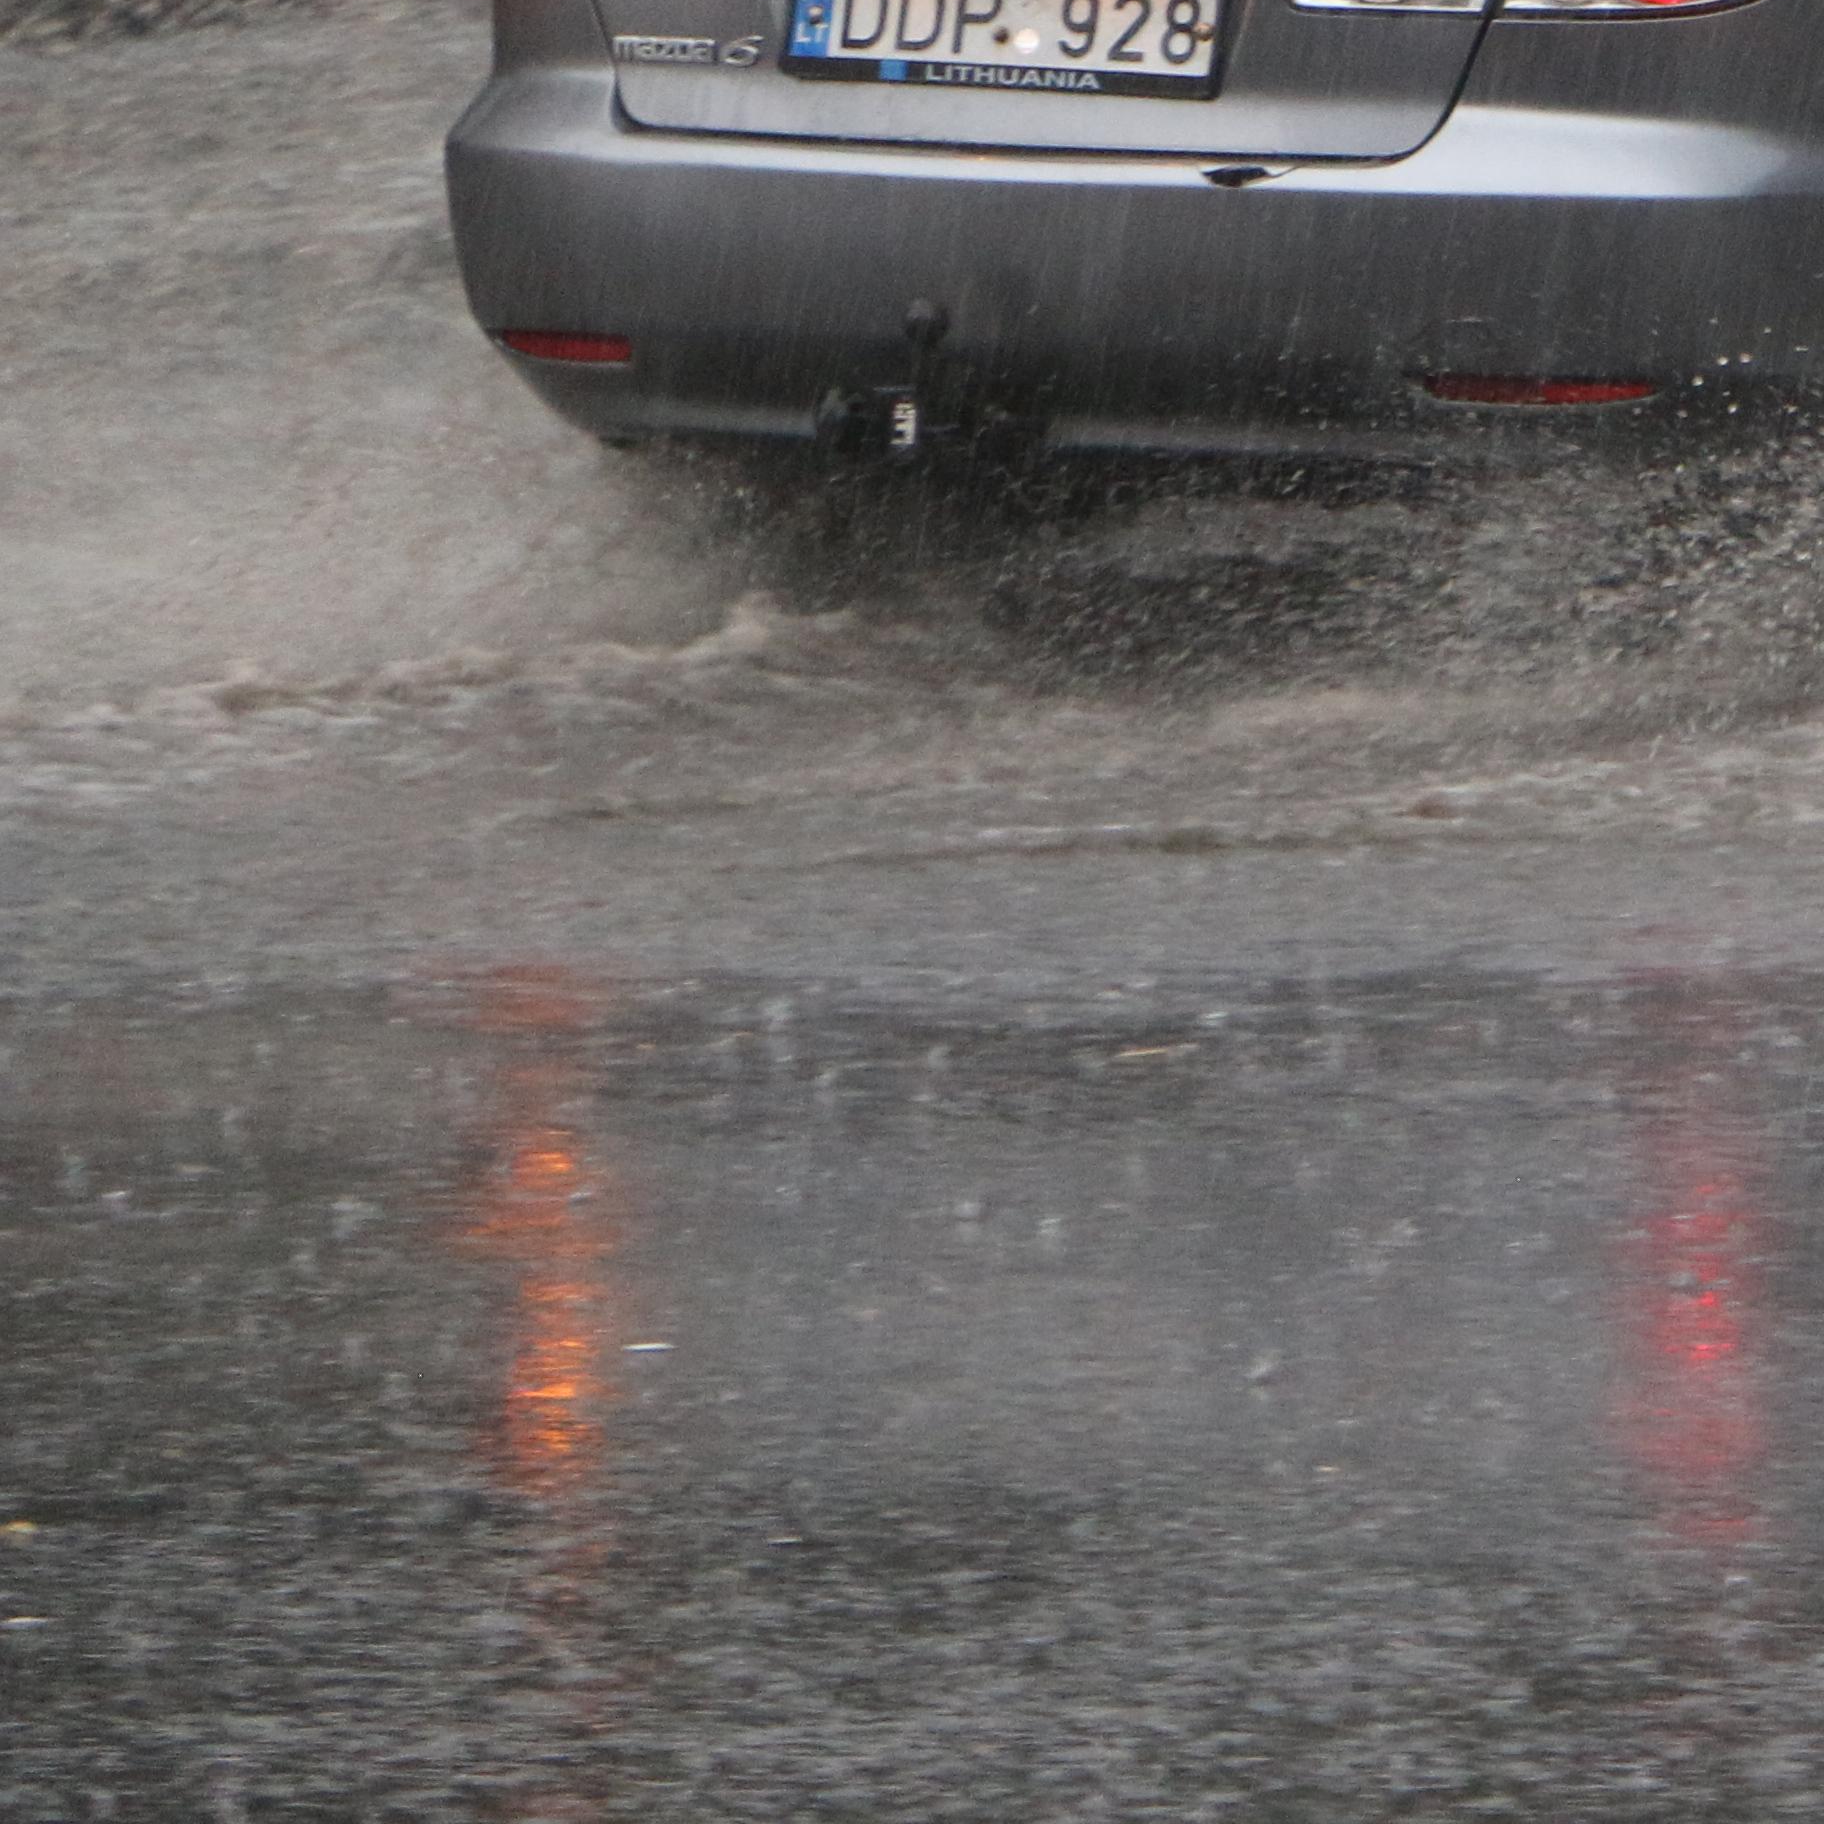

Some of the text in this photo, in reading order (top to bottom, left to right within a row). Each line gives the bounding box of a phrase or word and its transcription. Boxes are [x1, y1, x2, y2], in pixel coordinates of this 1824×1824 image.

[796, 22, 828, 44] LT
[720, 33, 765, 69] 6
[925, 63, 1101, 91] LITHUANIA
